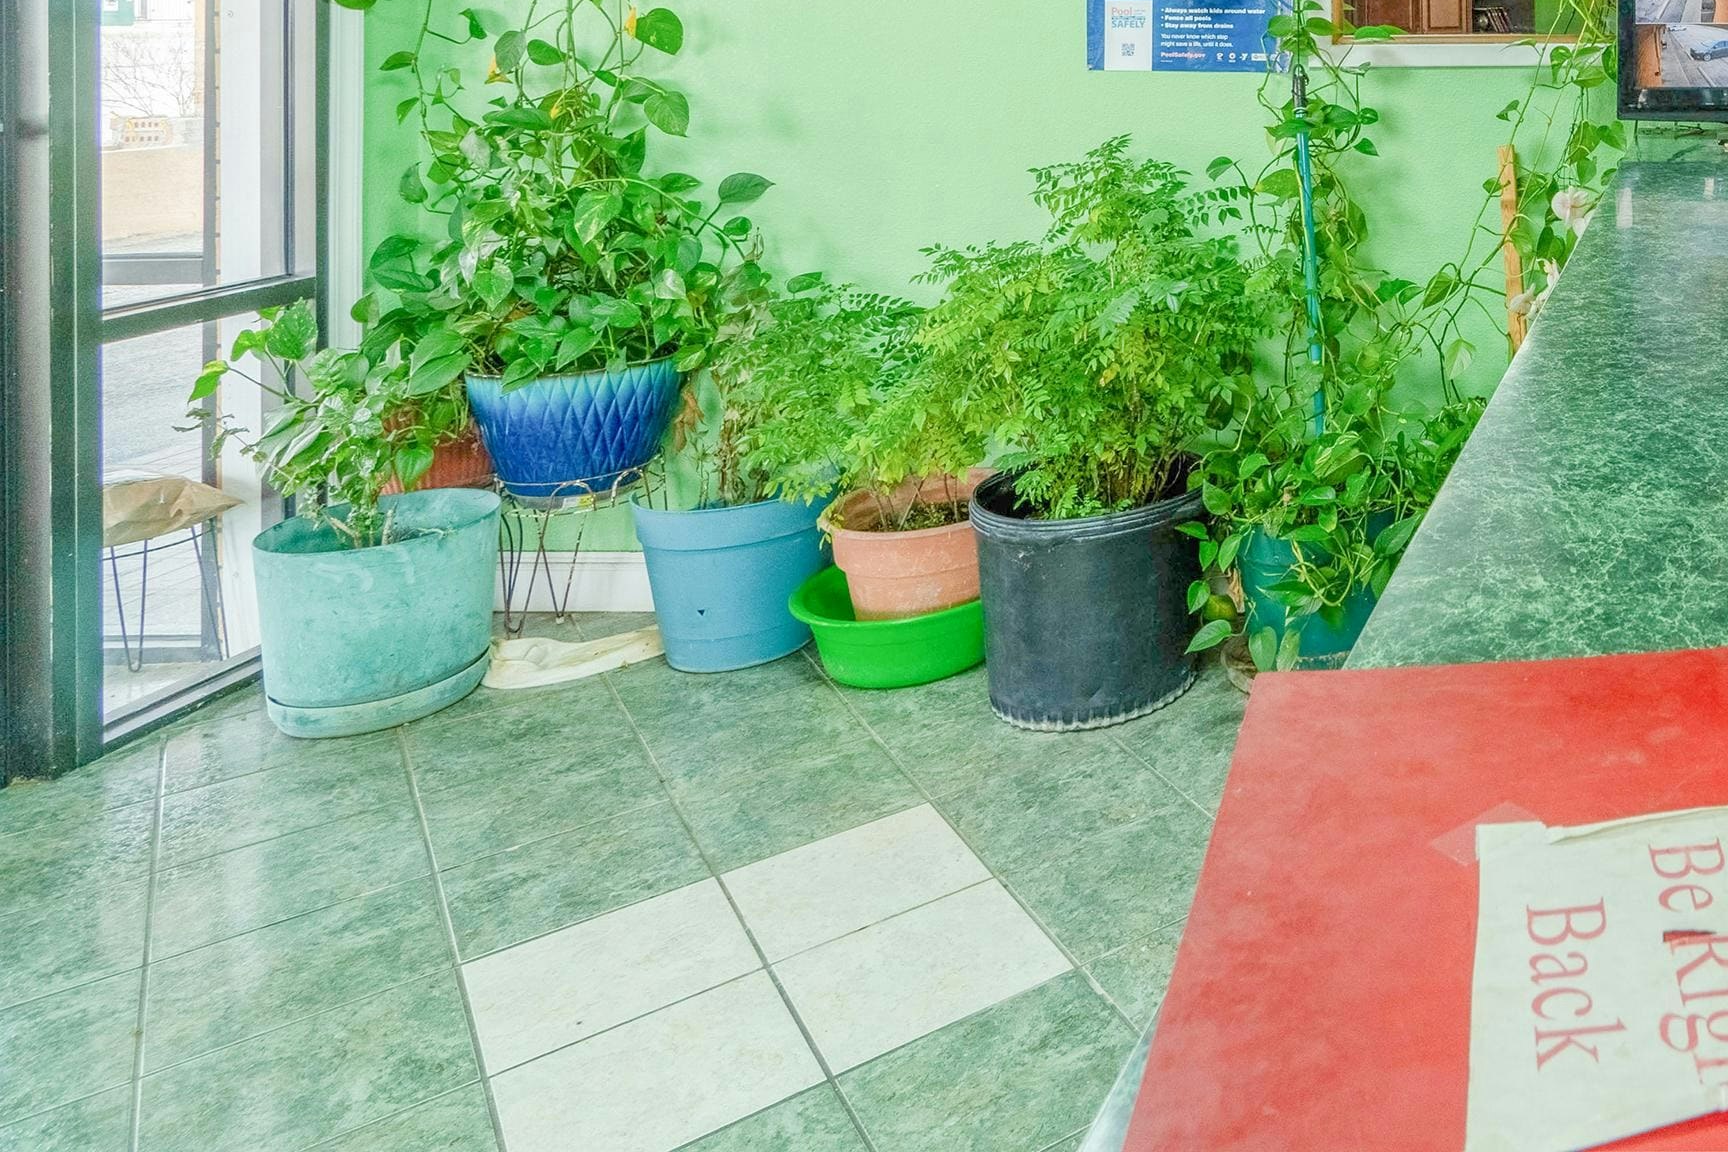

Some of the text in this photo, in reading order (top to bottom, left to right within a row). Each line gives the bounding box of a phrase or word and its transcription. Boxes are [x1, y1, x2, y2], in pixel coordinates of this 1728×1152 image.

[1111, 7, 1132, 15] Pool
[1111, 20, 1145, 28] SAFELY
[1648, 836, 1726, 914] Be
[1525, 896, 1626, 1072] Back
